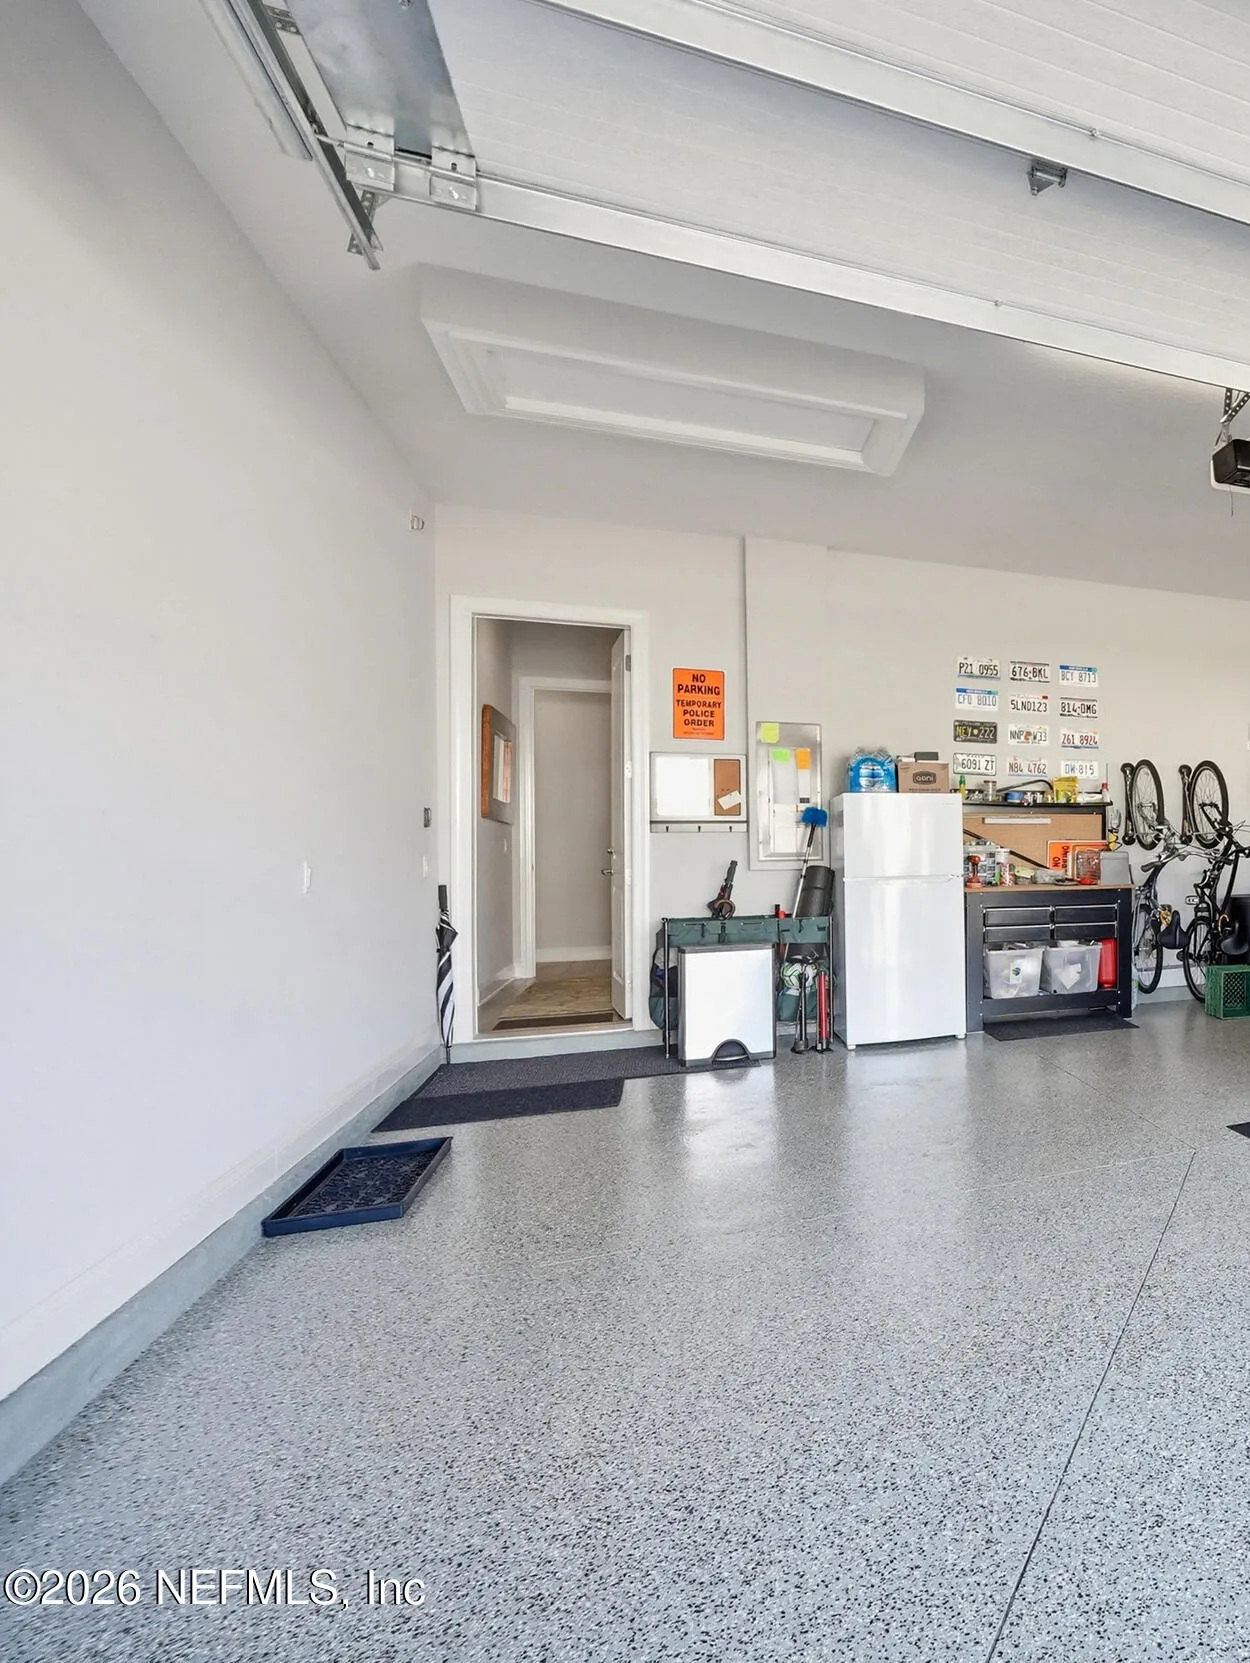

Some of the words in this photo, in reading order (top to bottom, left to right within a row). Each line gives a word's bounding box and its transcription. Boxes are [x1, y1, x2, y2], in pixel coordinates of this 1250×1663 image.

[692, 674, 706, 683] NO
[677, 684, 720, 696] PARKING
[676, 699, 721, 709] TEMPORARY
[683, 709, 715, 718] POLICE
[684, 719, 714, 727] ORDER
